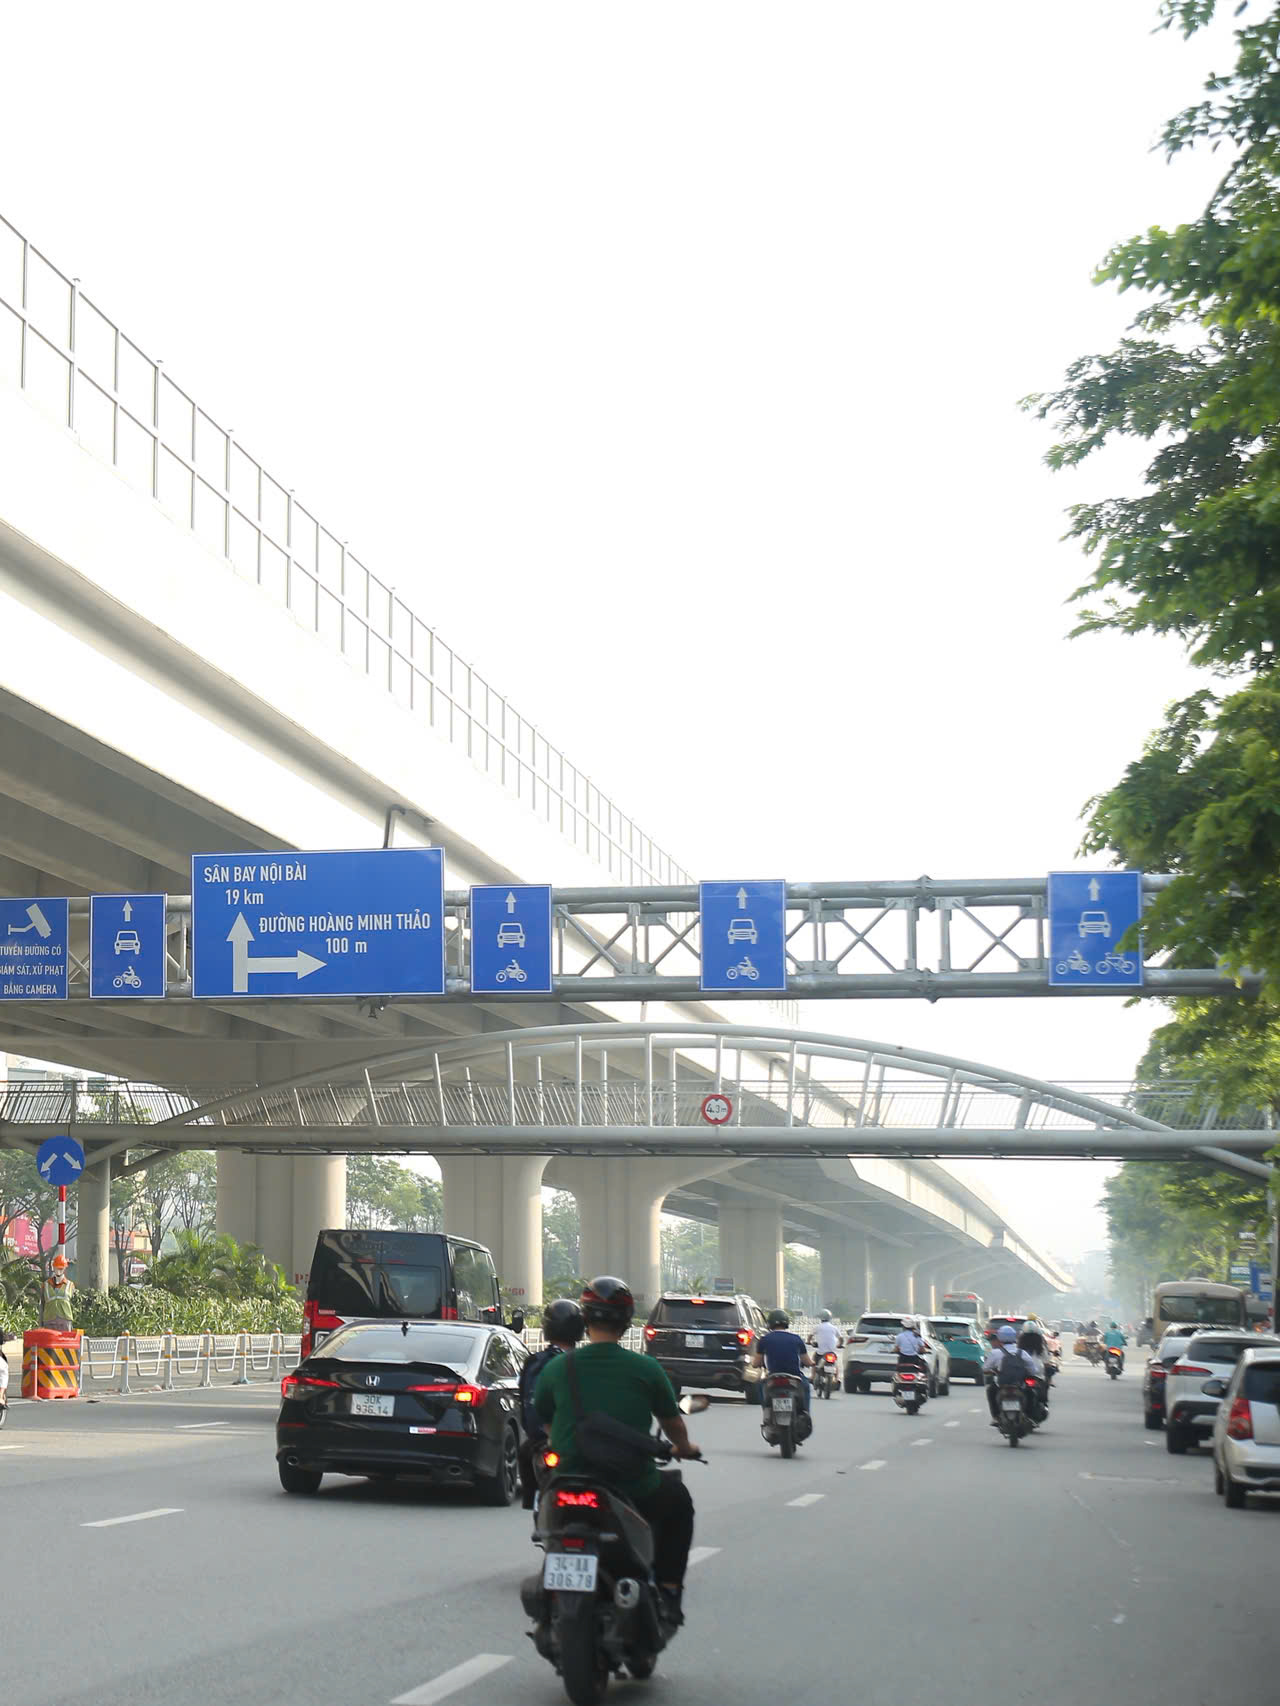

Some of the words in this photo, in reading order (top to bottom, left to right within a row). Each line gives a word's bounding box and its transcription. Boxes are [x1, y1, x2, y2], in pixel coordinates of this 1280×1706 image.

[204, 864, 229, 883] SÂN
[234, 866, 256, 882] BAY
[260, 863, 282, 885] NỘI
[285, 861, 307, 881] BÀI
[225, 889, 240, 905] 19
[244, 889, 264, 905] km
[259, 912, 305, 933] ĐƯỜNG
[309, 912, 354, 932] HOÀNG
[358, 914, 392, 931] MINH
[396, 909, 431, 930] THẢO
[51, 943, 62, 956] CÓ
[325, 938, 349, 954] 100
[355, 941, 368, 953] m
[44, 965, 65, 977] PHẠT
[25, 984, 58, 995] CAMERA
[363, 1395, 382, 1405] 30K
